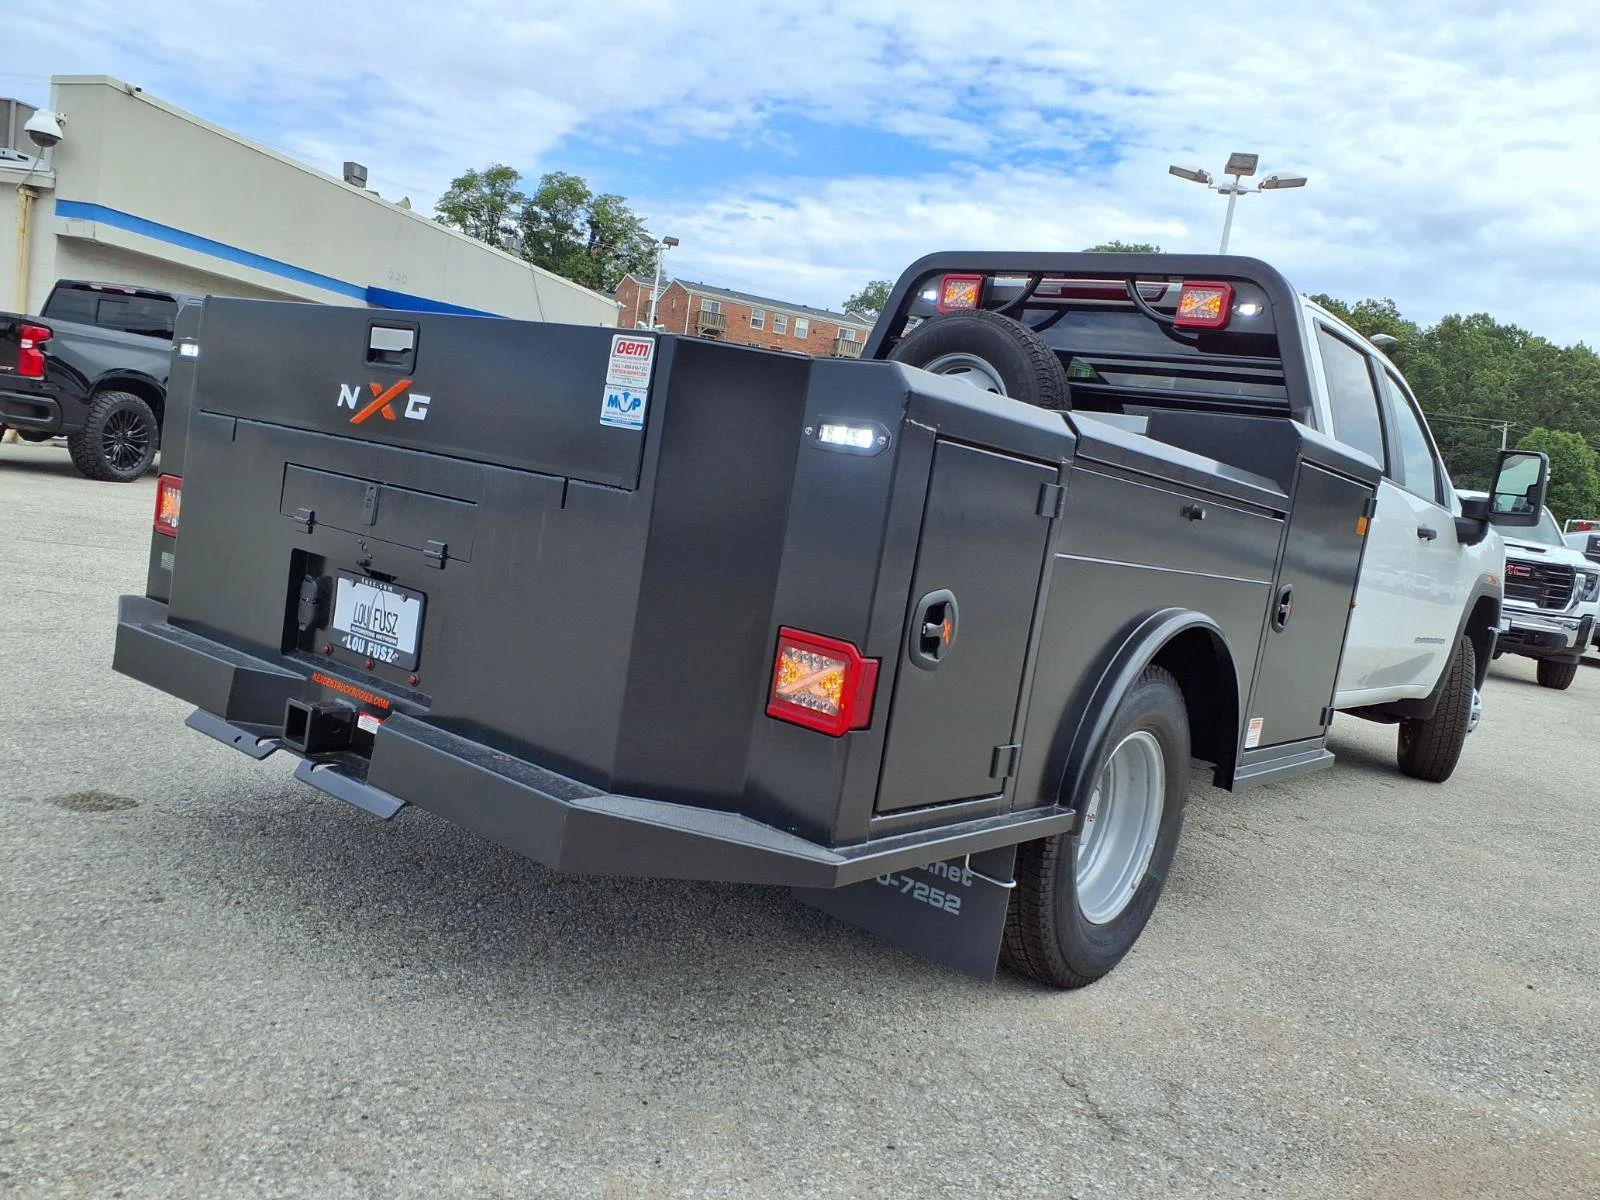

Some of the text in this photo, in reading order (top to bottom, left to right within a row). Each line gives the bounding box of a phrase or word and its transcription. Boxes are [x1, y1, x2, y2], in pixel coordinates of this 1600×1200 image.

[616, 341, 649, 357] oem
[607, 391, 641, 413] MVP
[353, 601, 399, 636] LOU FUSZ
[346, 635, 394, 663] LOU FUSZ
